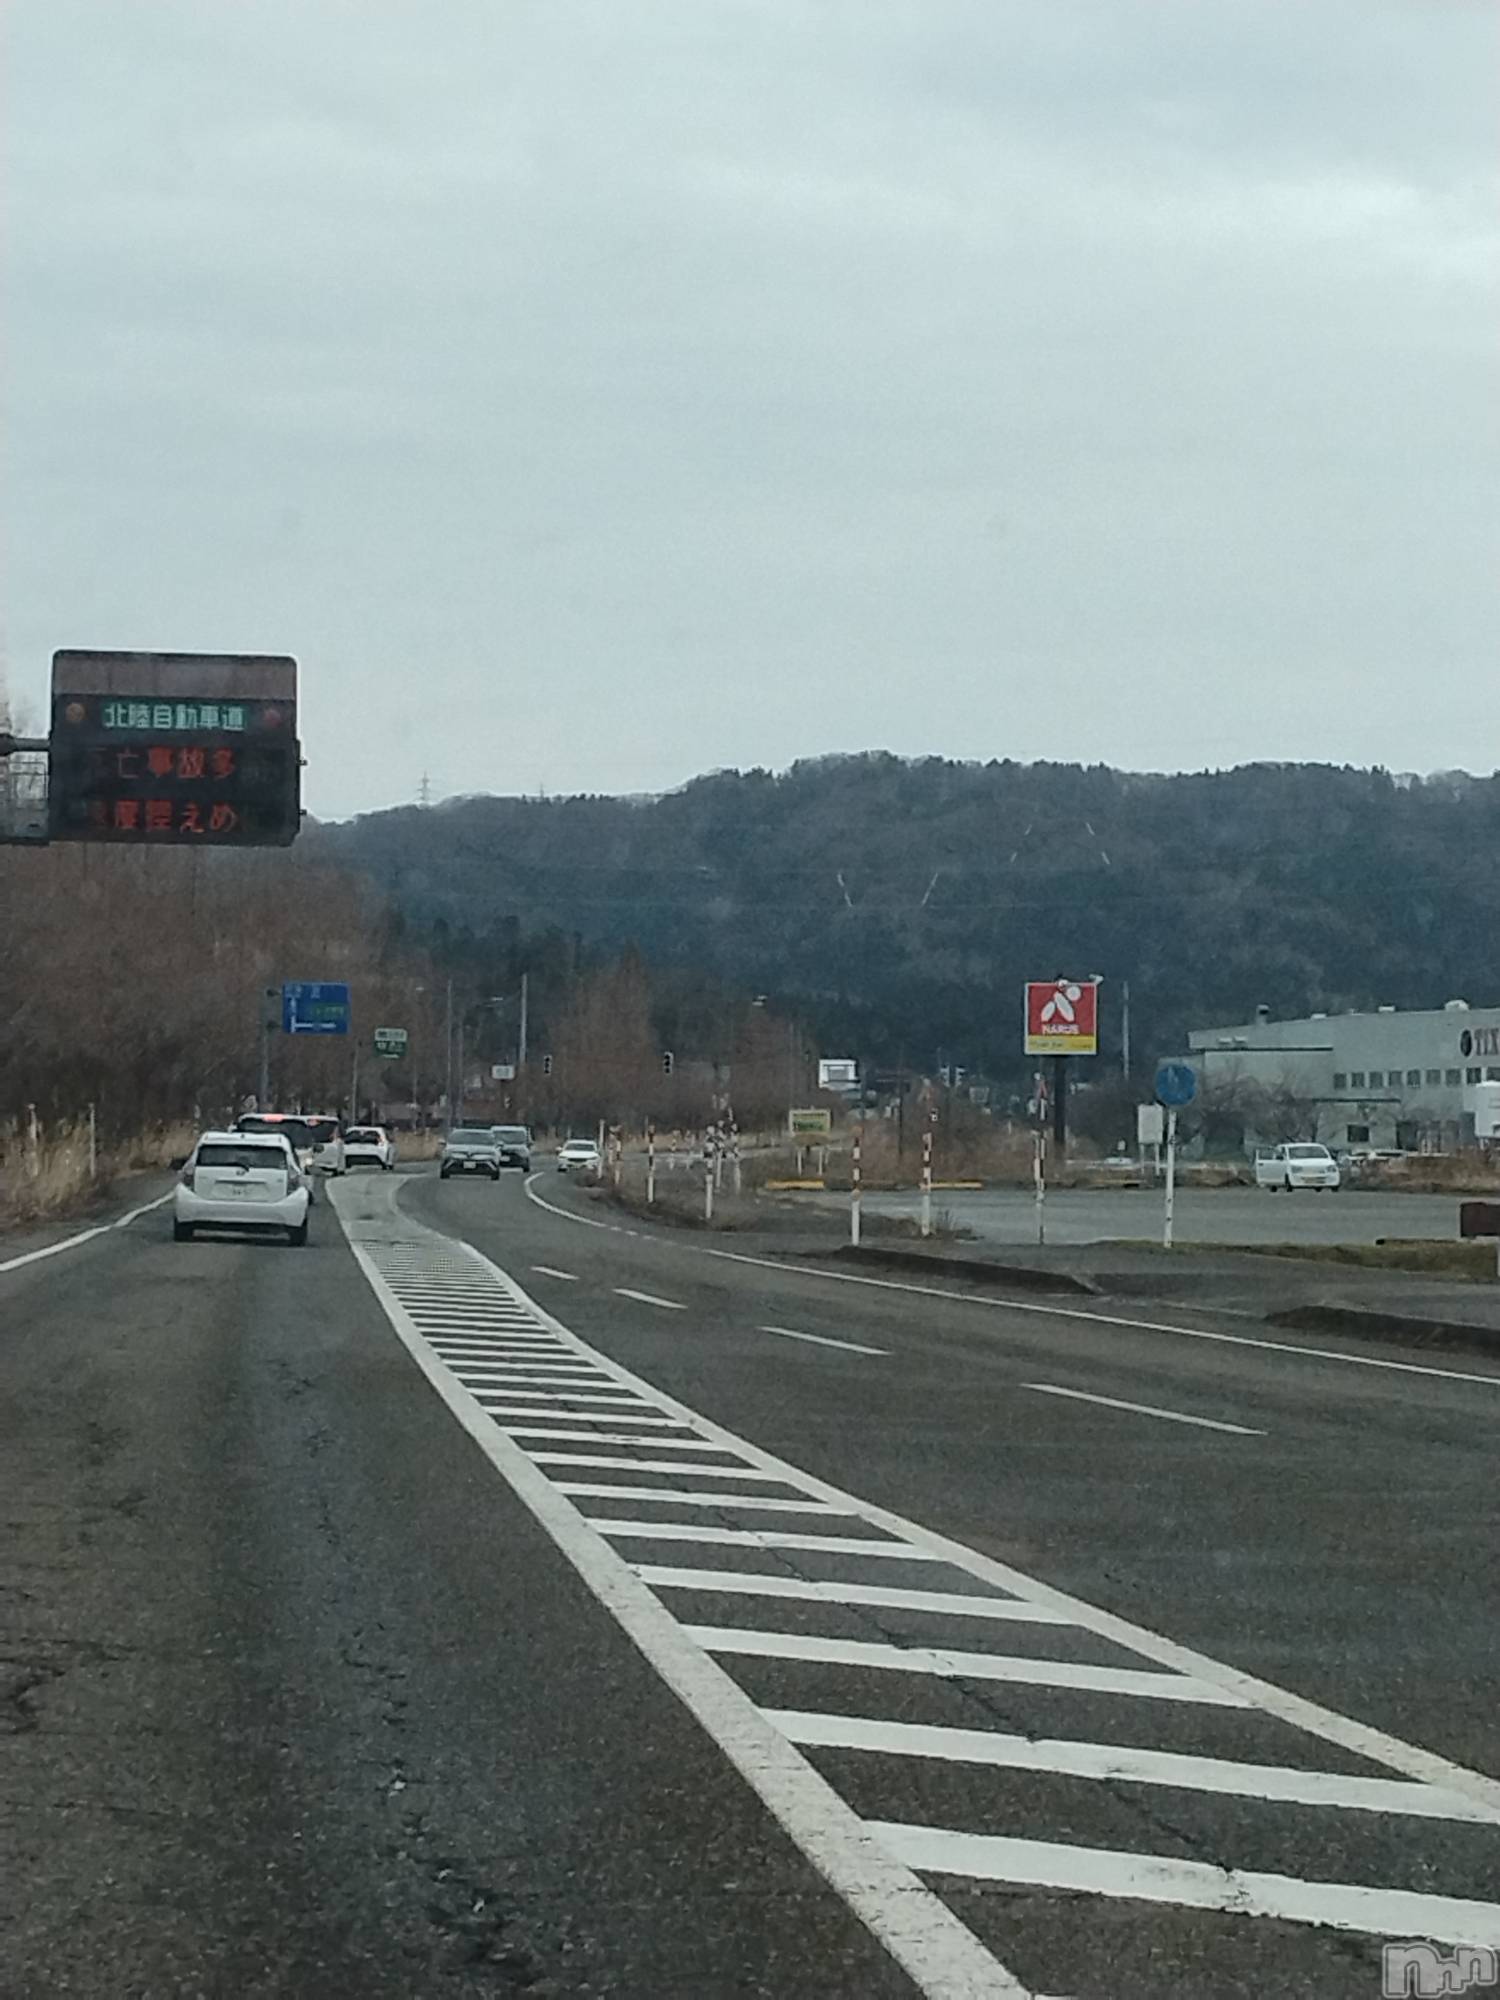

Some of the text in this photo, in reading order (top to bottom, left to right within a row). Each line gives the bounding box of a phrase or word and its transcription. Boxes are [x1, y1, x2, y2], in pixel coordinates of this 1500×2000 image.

[104, 704, 244, 731] 北陸自動車道
